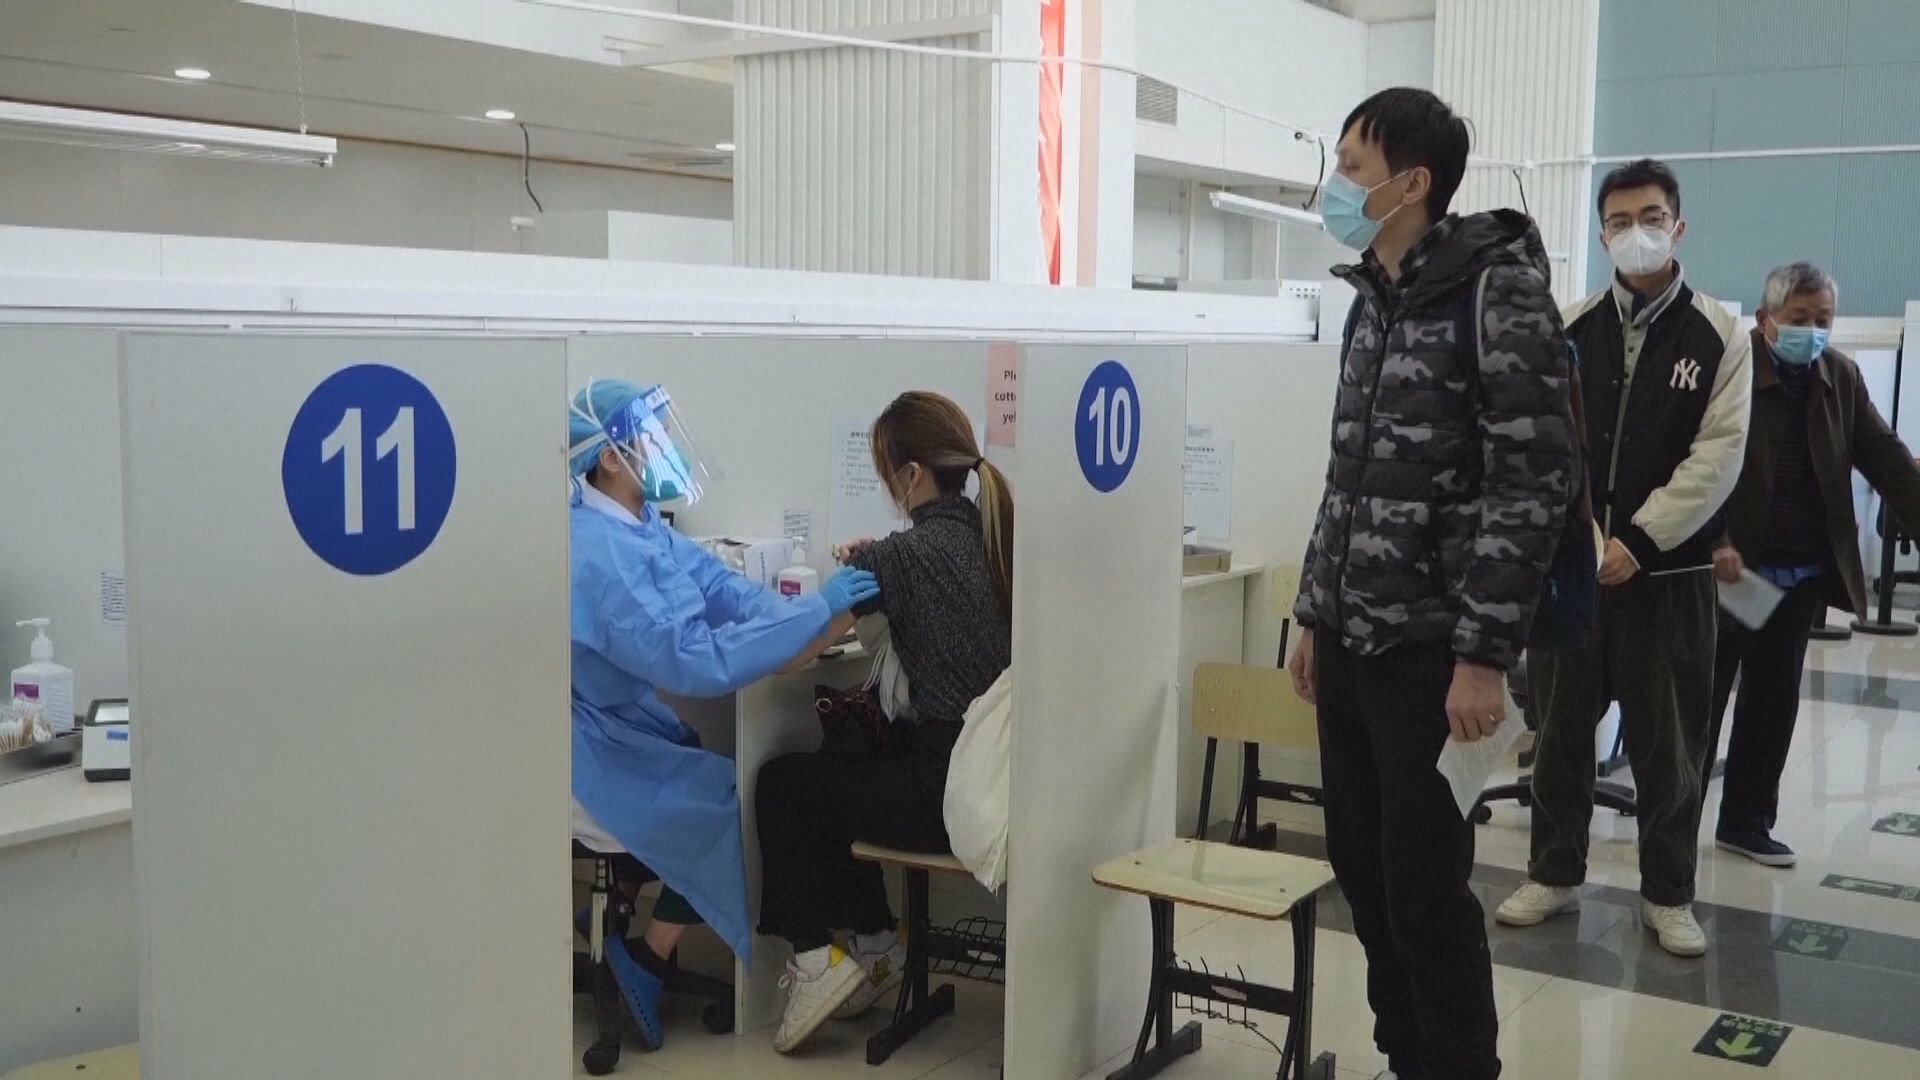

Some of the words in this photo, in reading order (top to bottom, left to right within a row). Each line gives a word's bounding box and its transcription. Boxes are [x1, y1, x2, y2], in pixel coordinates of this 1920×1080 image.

[994, 392, 1016, 401] cott
[1669, 358, 1701, 391] NY
[1088, 386, 1132, 466] 10
[321, 406, 416, 535] 11
